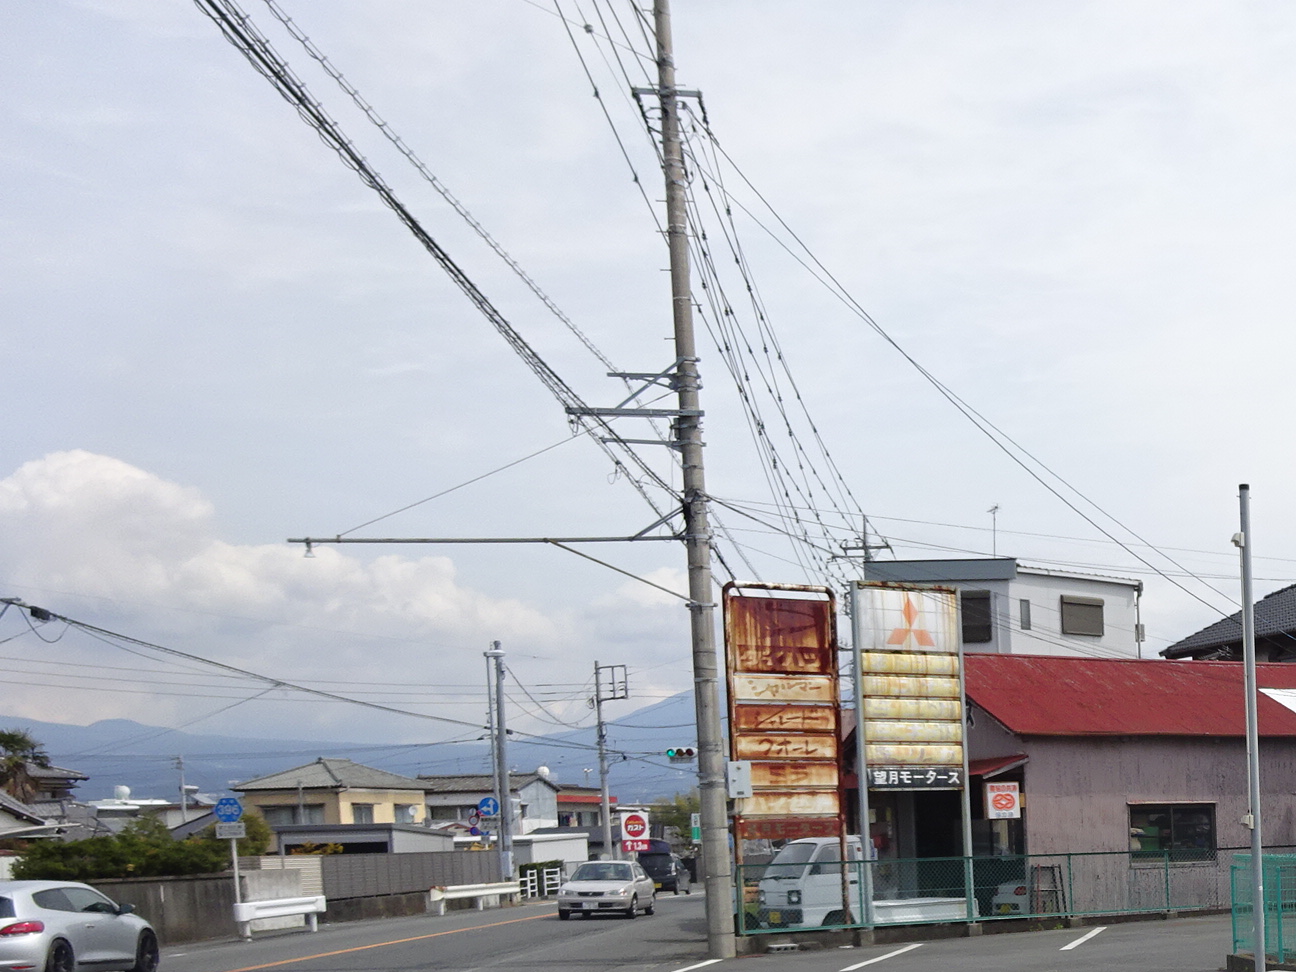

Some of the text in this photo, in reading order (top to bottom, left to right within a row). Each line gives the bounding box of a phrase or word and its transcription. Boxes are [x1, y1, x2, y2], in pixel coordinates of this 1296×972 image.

[873, 769, 960, 785] 望月モータース
[627, 824, 645, 832] ガスト
